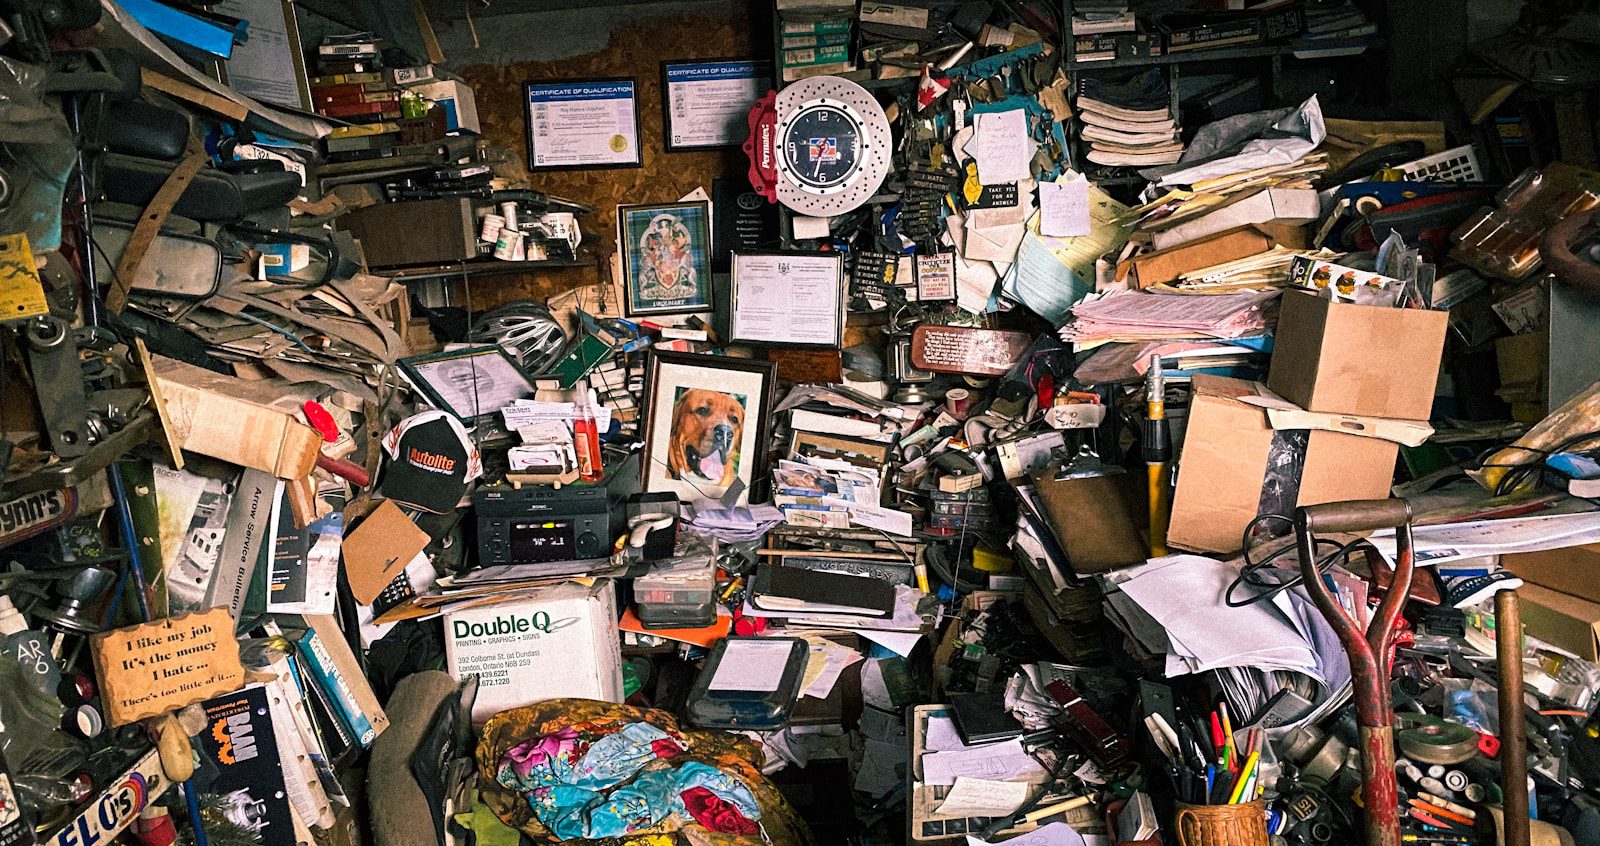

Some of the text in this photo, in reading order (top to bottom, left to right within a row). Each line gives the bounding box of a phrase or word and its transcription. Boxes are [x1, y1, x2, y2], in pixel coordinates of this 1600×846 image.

[668, 68, 708, 76] CERTIFICATE
[531, 88, 571, 96] CERTIFICATE
[583, 86, 632, 94] QUALIFICATION
[818, 112, 828, 121] 12
[819, 173, 826, 182] 6
[410, 448, 455, 470] Autolite
[250, 487, 262, 519] Arrow
[241, 523, 254, 563] Service
[231, 567, 245, 610] Bulletin
[454, 610, 552, 639] Double Q
[127, 624, 212, 651] I like my job
[456, 633, 540, 647] PRINTING GRAPHICS SIGNS
[17, 640, 45, 662] AR
[122, 640, 218, 670] It's the money
[458, 650, 540, 664] 392 Colborne St. (at Dundas)
[35, 656, 49, 674] 6
[153, 671, 158, 680] I
[163, 664, 193, 678] hate
[458, 659, 531, 673] London, Ontario N6B 2S9
[468, 670, 508, 680] 51.439.6221
[121, 692, 158, 708] There's
[161, 688, 177, 696] too
[180, 681, 202, 692] little
[205, 677, 214, 685] of
